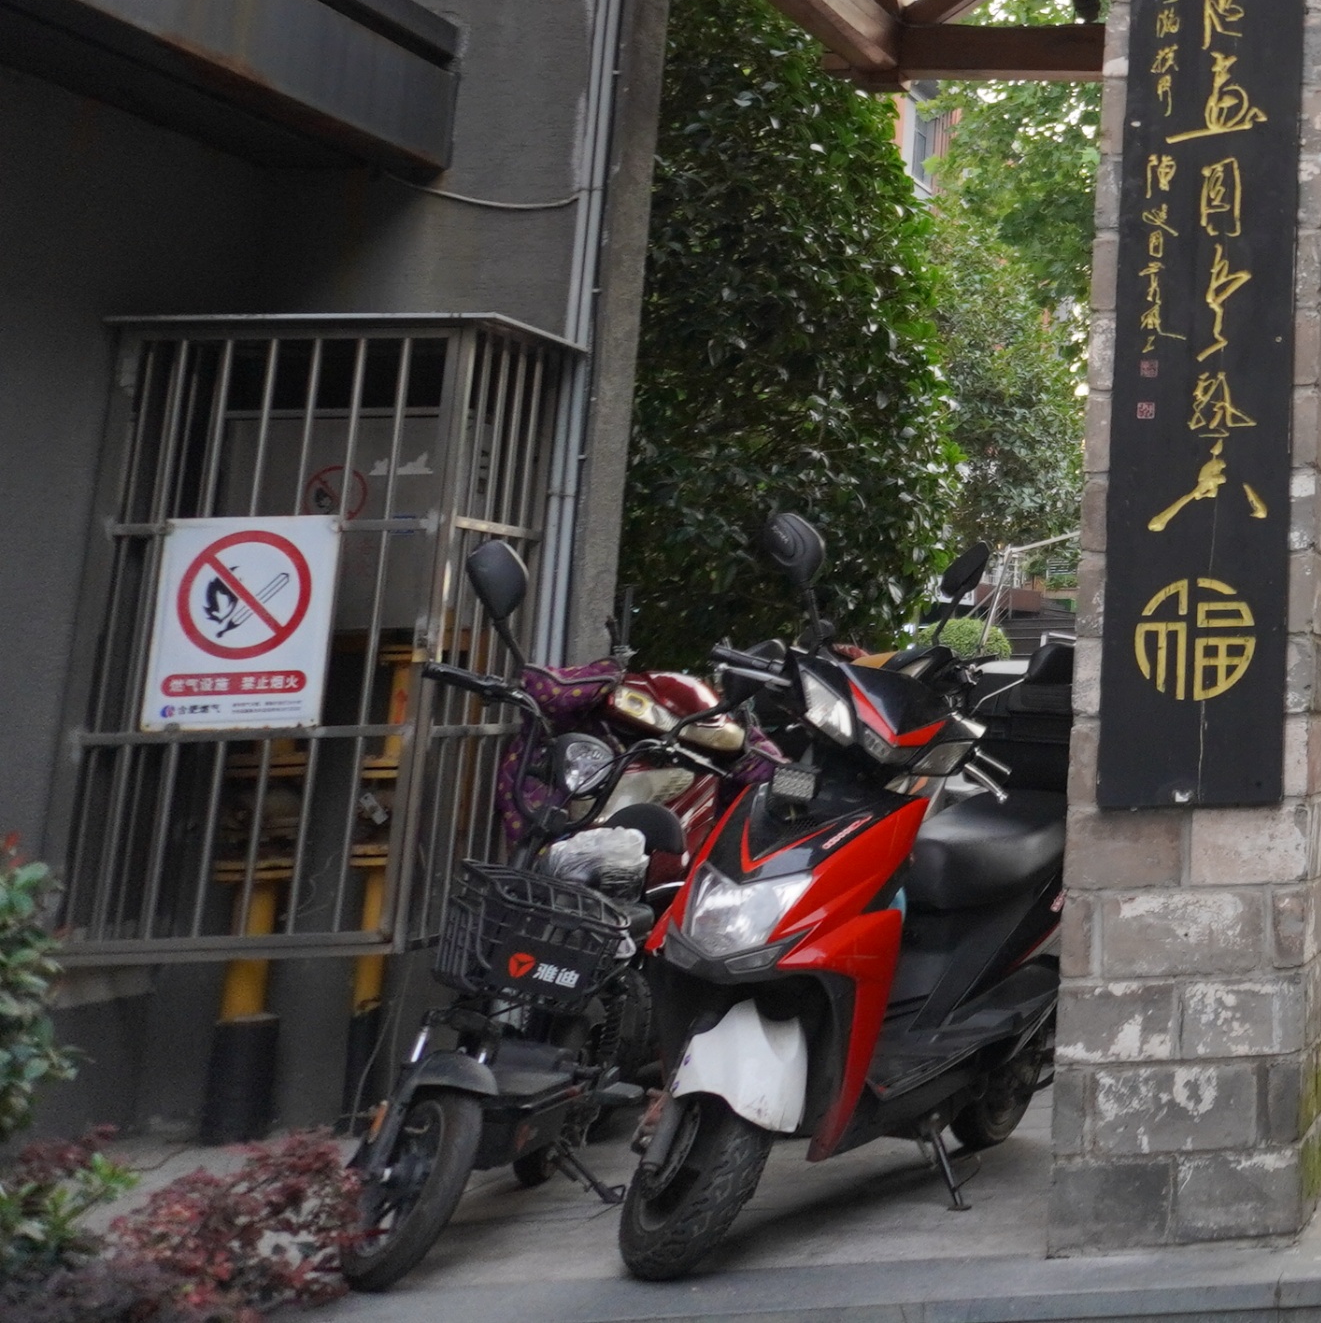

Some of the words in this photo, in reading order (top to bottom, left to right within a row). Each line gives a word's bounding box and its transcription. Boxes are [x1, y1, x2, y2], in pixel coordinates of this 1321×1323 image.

[241, 675, 299, 691] 禁止烟火
[532, 962, 581, 989] 雅迪
